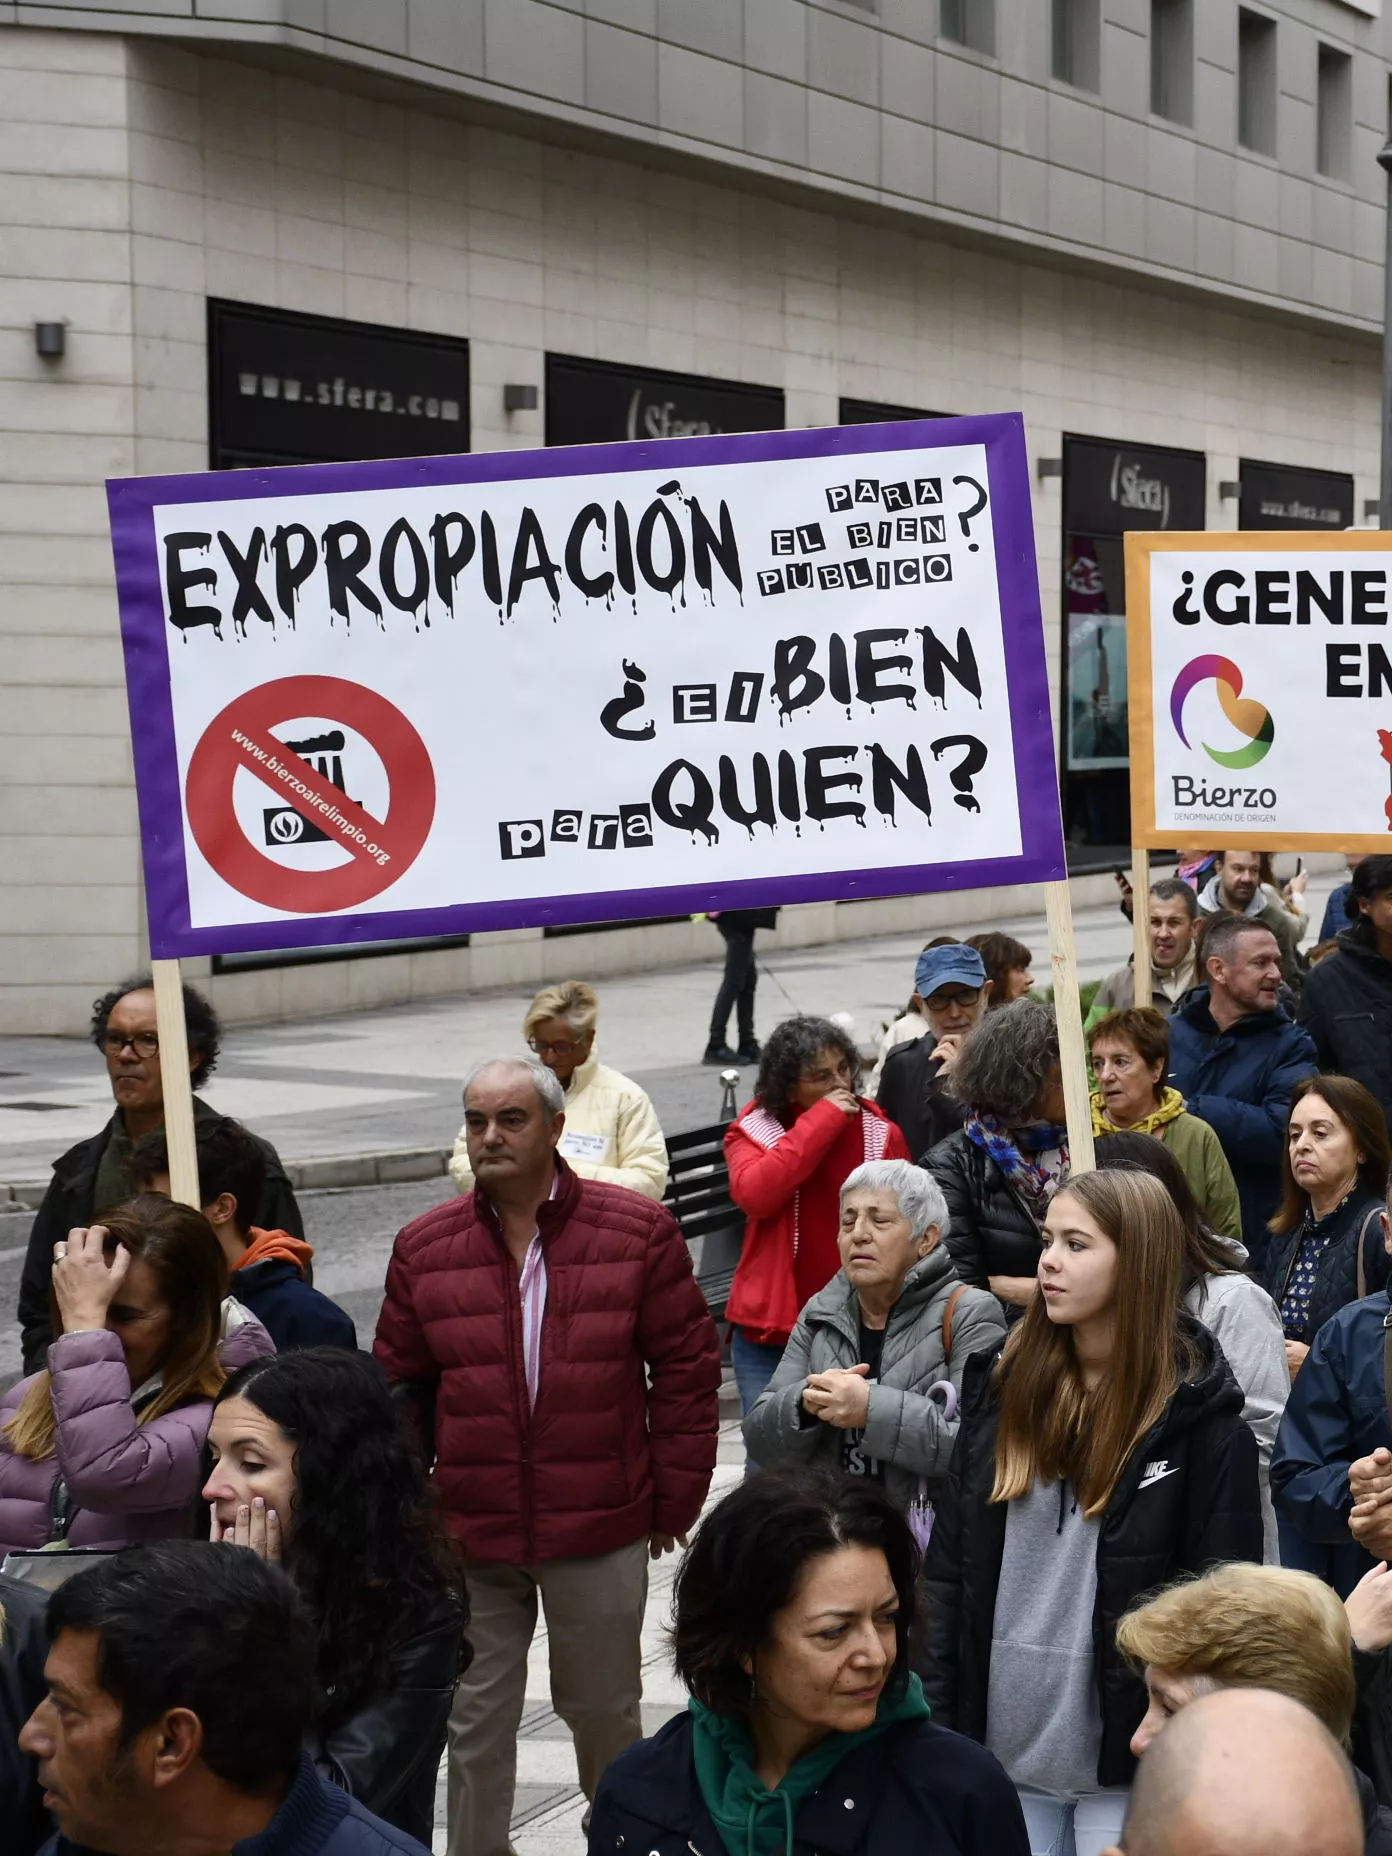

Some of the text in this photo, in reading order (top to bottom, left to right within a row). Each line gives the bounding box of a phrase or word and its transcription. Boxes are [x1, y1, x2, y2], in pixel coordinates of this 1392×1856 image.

[238, 372, 460, 422] www.sfera.com
[163, 480, 744, 643] EXPROPIACIÓN
[771, 515, 946, 555] EL BIEN
[770, 626, 983, 727] BIEN
[231, 729, 391, 866] www.bierzoairelimpio.org
[498, 735, 988, 860] para QUIEN?
[1171, 775, 1277, 809] Bierzo
[1174, 811, 1277, 823] DENOMINACIÓN DE ORIGEN
